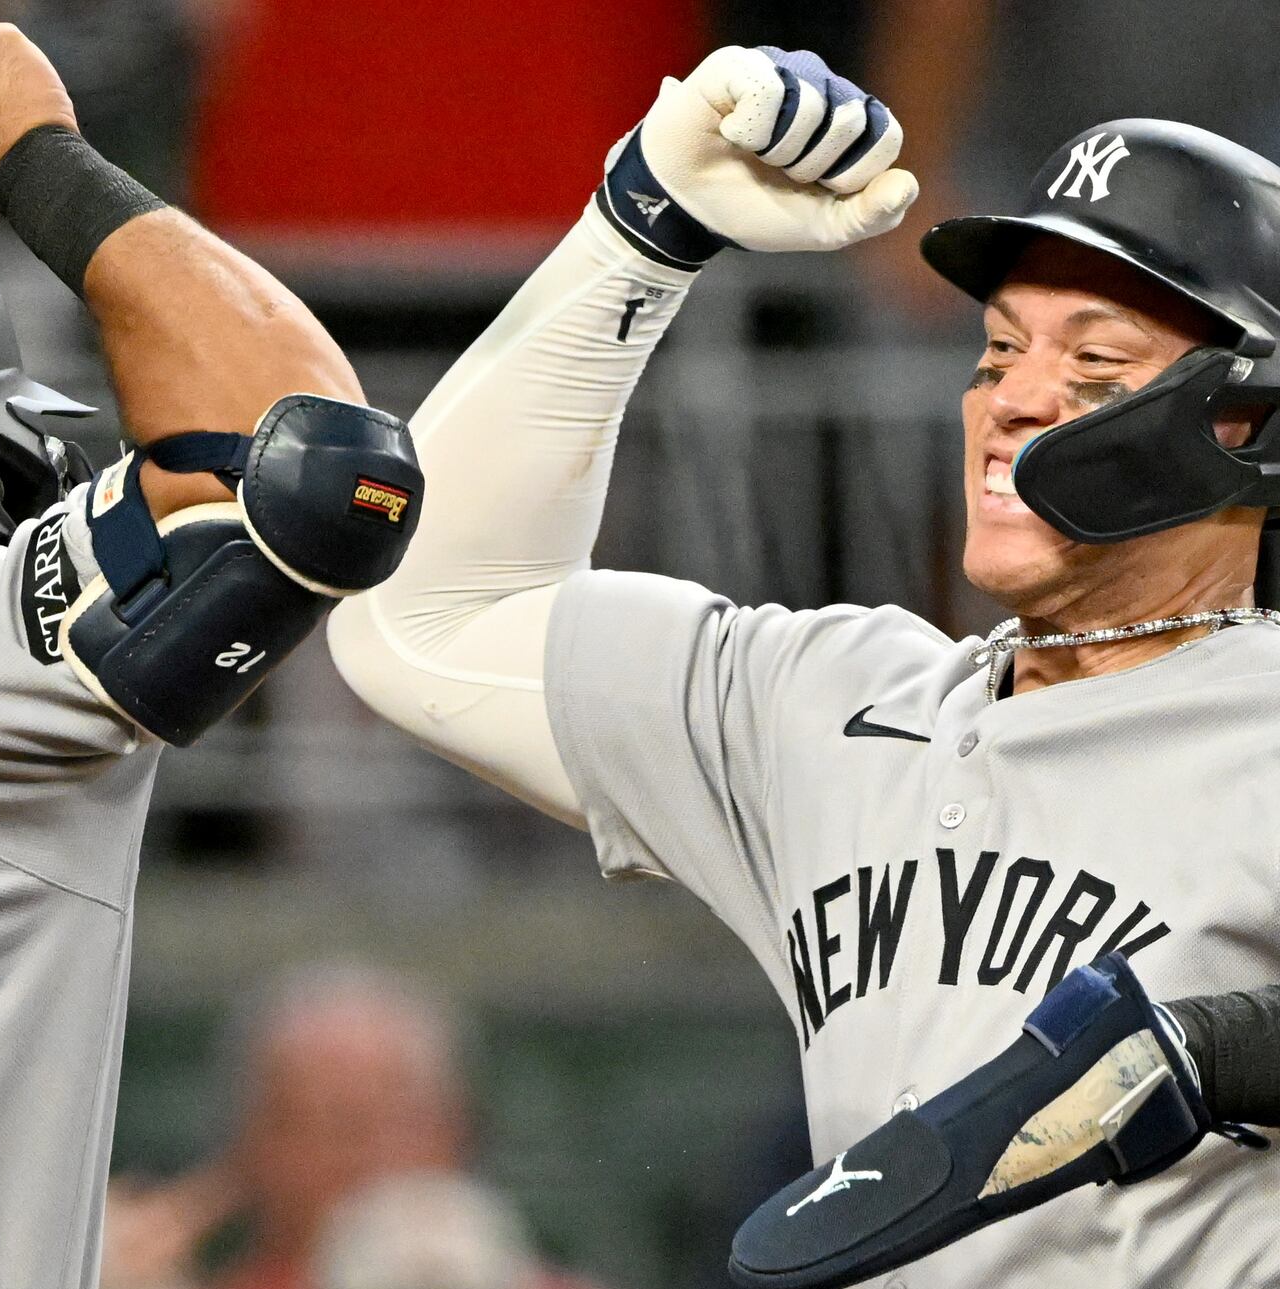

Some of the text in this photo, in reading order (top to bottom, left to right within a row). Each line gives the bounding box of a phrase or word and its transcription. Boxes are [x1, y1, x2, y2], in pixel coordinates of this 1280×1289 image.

[1047, 132, 1131, 203] NY
[215, 641, 266, 673] 12
[787, 859, 918, 1053] NEW
